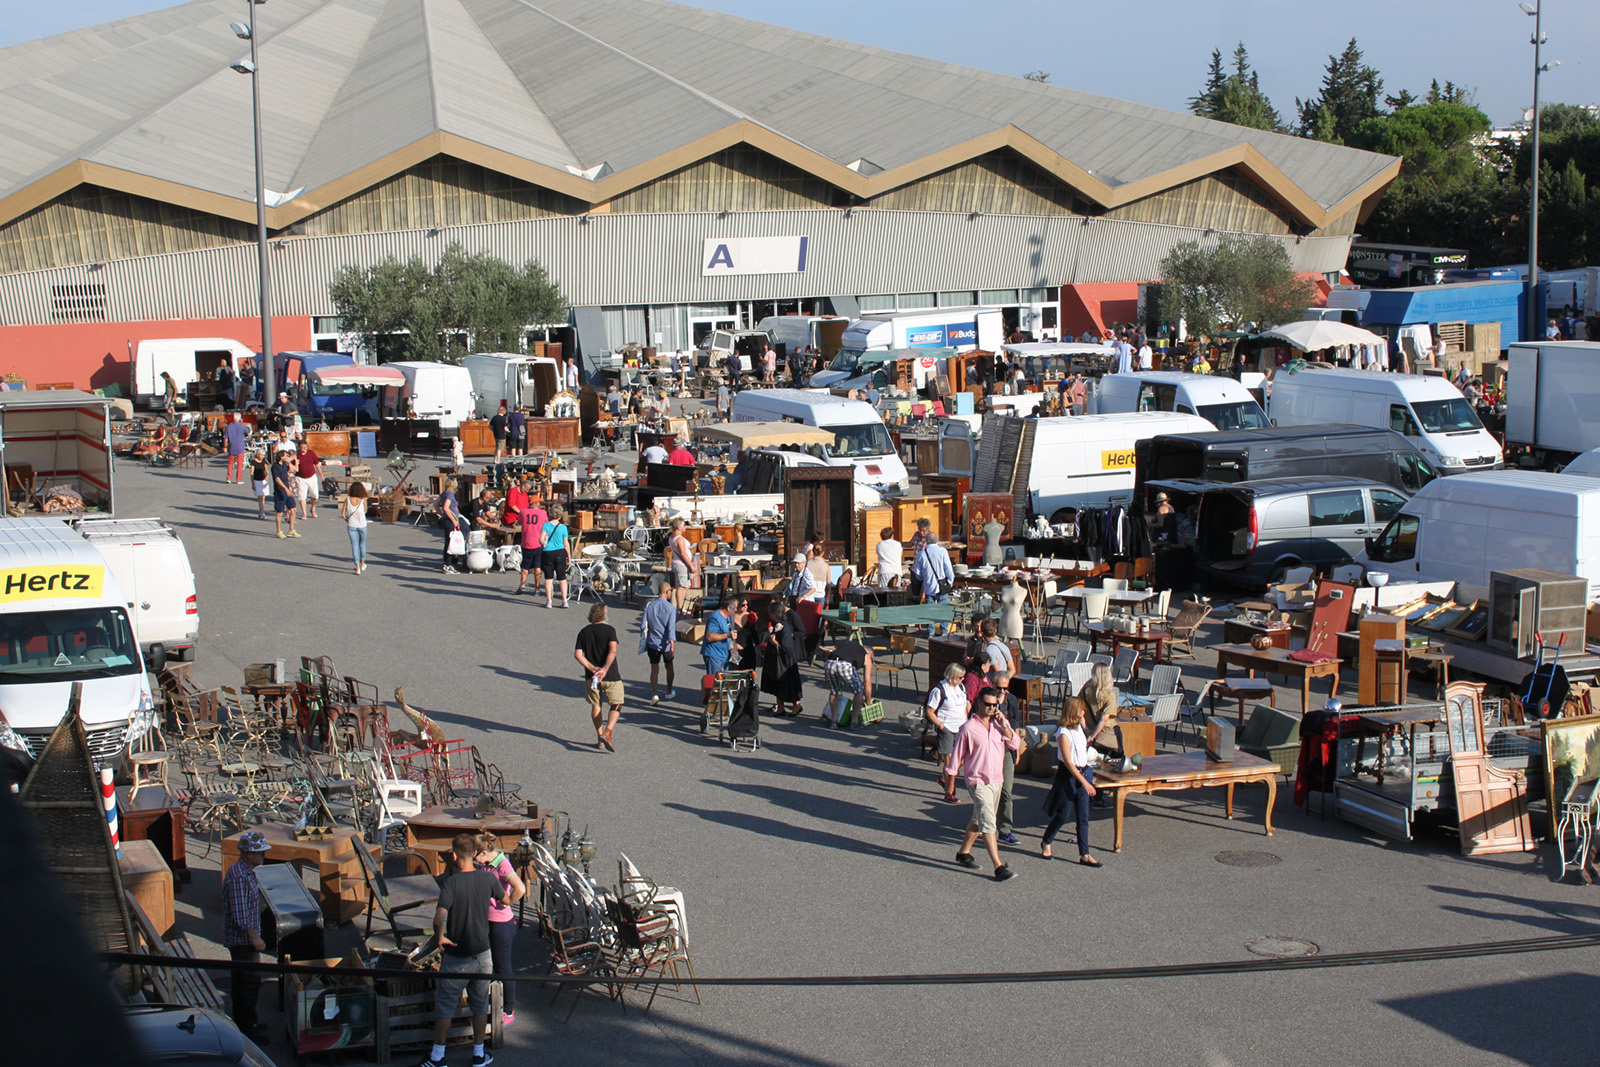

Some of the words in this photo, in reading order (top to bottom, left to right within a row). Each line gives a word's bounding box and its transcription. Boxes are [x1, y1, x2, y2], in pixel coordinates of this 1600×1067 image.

[707, 244, 734, 269] A
[1349, 250, 1387, 261] MONSTER
[526, 513, 539, 525] 10
[5, 571, 90, 594] Hertz
